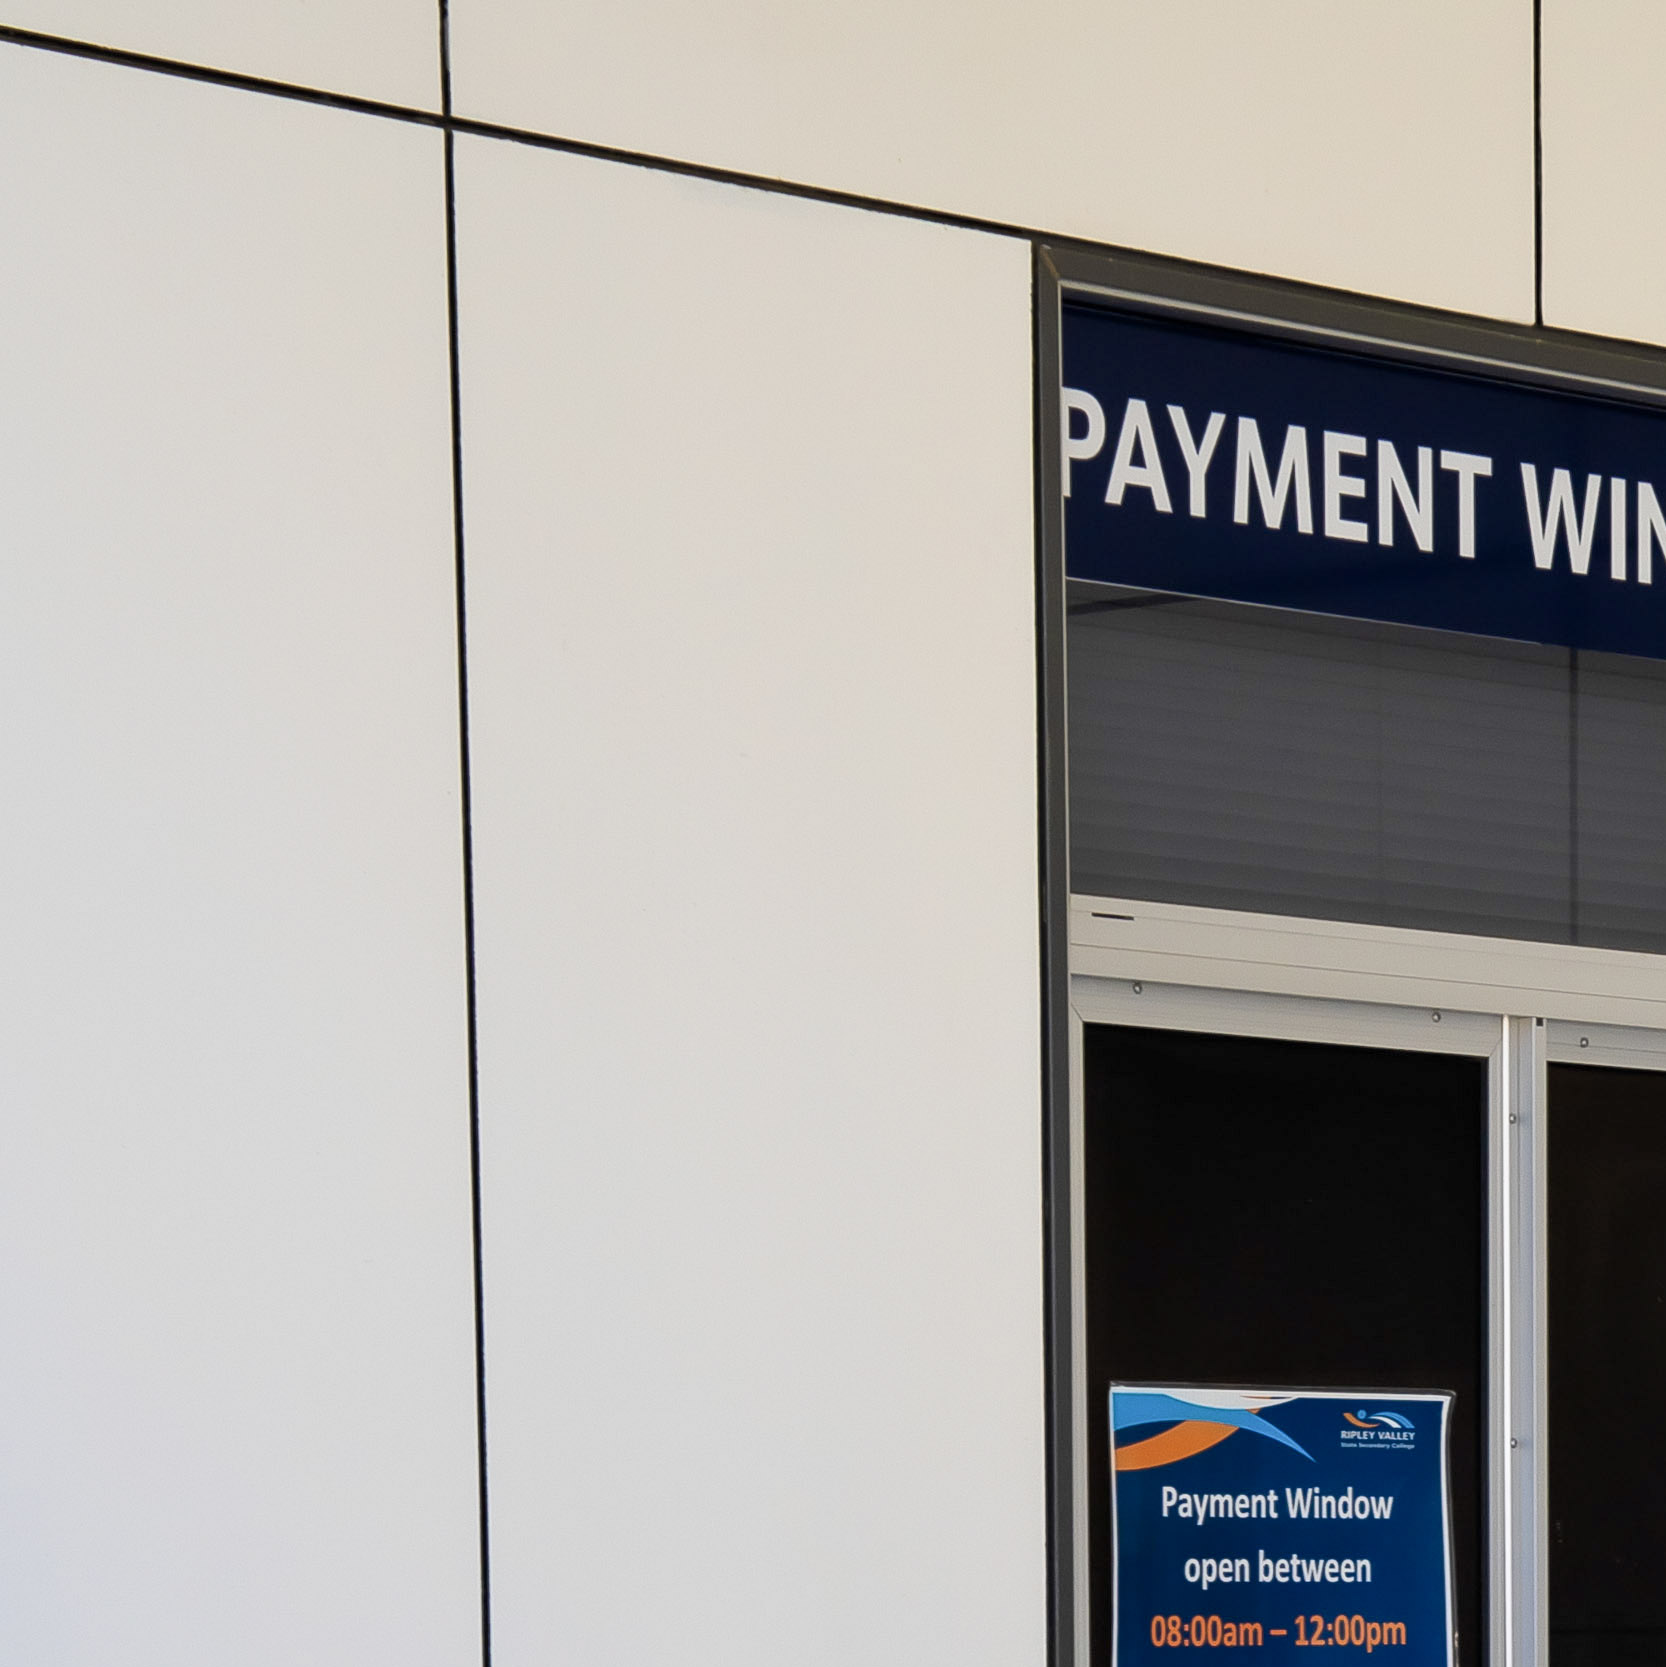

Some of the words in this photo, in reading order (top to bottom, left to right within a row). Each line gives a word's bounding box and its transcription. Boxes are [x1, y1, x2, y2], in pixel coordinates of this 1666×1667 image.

[1061, 385, 1492, 560] PAYMENT
[1340, 1430, 1375, 1440] RIPLEY
[1377, 1431, 1415, 1440] VALLEY
[1162, 1486, 1278, 1525] Payment
[1285, 1487, 1393, 1519] Window
[1185, 1559, 1249, 1590] open
[1258, 1550, 1372, 1582] between
[1151, 1615, 1263, 1647] 08:00am
[1295, 1615, 1407, 1653] 12:00pm
